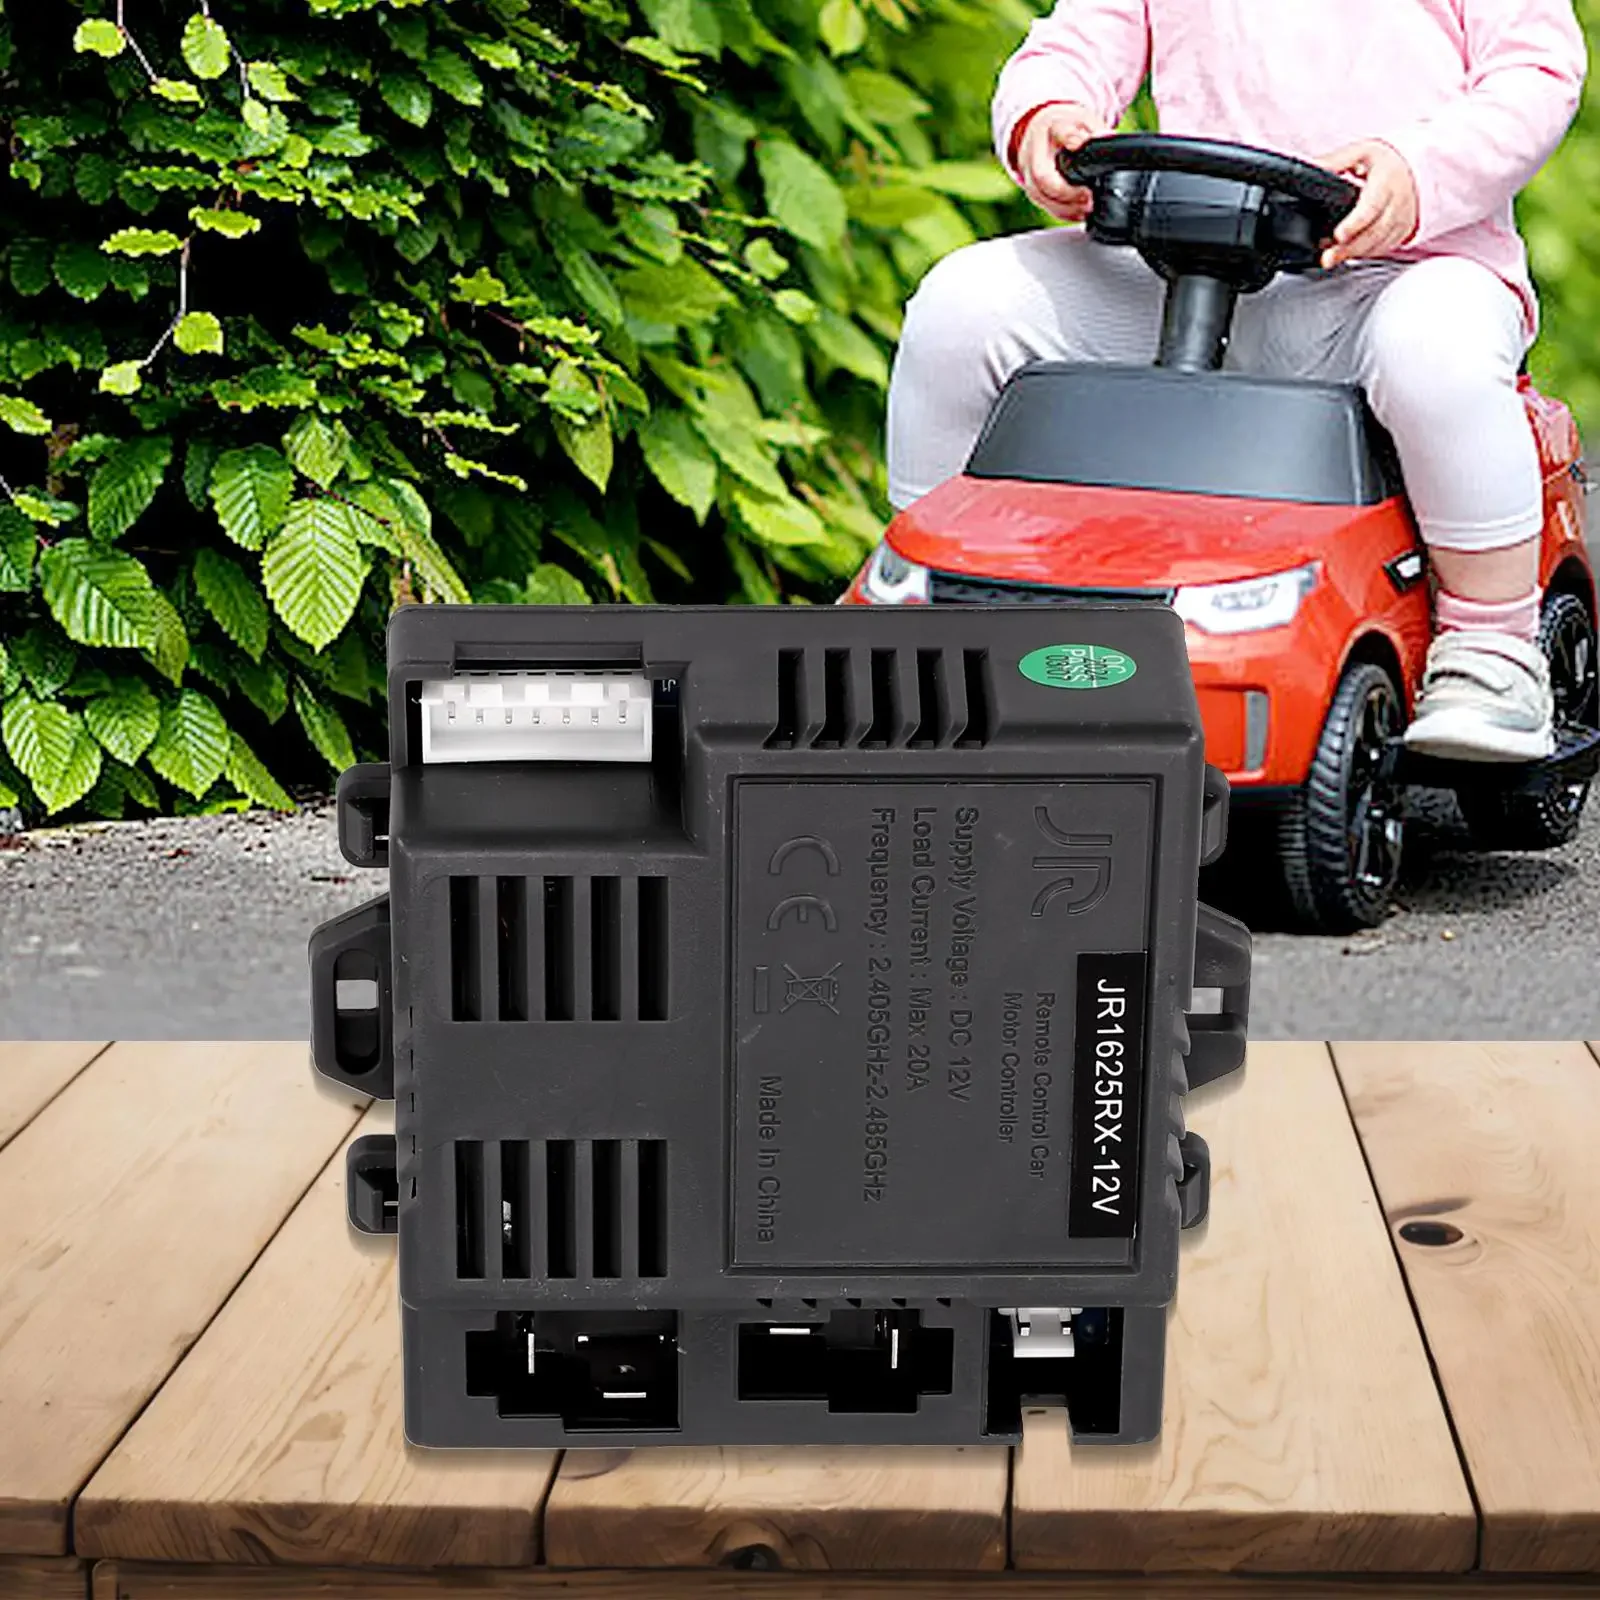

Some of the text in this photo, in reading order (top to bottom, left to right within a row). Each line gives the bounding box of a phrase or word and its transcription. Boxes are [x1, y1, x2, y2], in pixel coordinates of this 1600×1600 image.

[1061, 648, 1089, 682] PASS
[864, 807, 897, 936] Frequency
[911, 806, 938, 868] Load
[948, 806, 979, 891] Supply
[1031, 806, 1113, 917] JR
[909, 874, 936, 967] Current
[945, 896, 977, 988] Voltage
[908, 987, 933, 1038] Max
[949, 1009, 974, 1047] DC
[906, 1045, 931, 1092] 20A
[947, 1056, 973, 1102] 12V
[1000, 992, 1023, 1143] Motor Controller
[1030, 992, 1055, 1179] Remote Control Car
[1092, 979, 1126, 1215] JR1625RX-12V
[757, 1075, 783, 1243] Made In China
